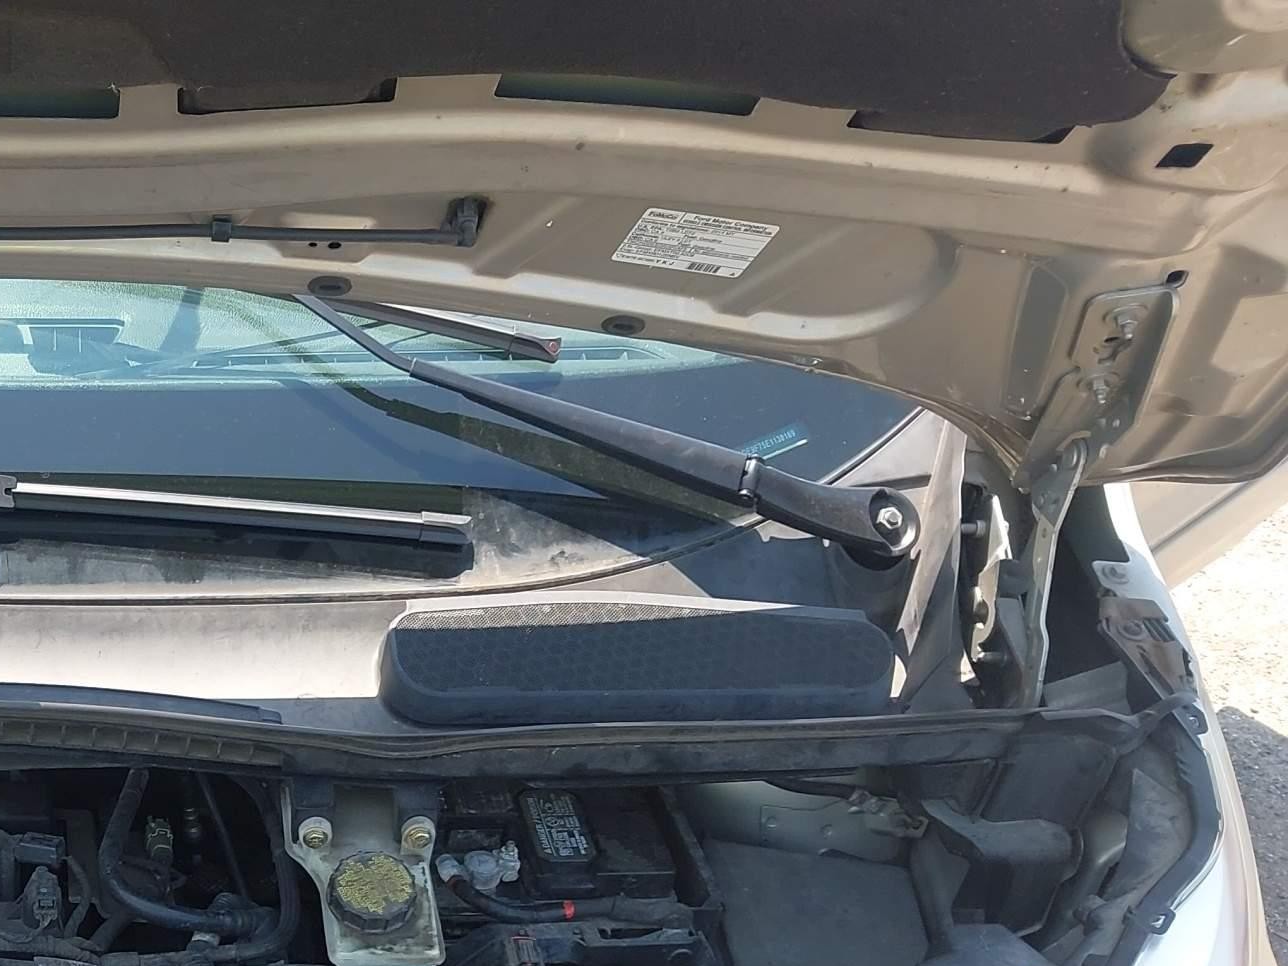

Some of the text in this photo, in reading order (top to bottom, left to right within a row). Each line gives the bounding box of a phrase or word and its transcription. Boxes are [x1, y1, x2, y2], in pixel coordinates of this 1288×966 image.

[693, 215, 712, 223] Ford
[712, 218, 734, 226] Motor
[734, 221, 768, 231] Company
